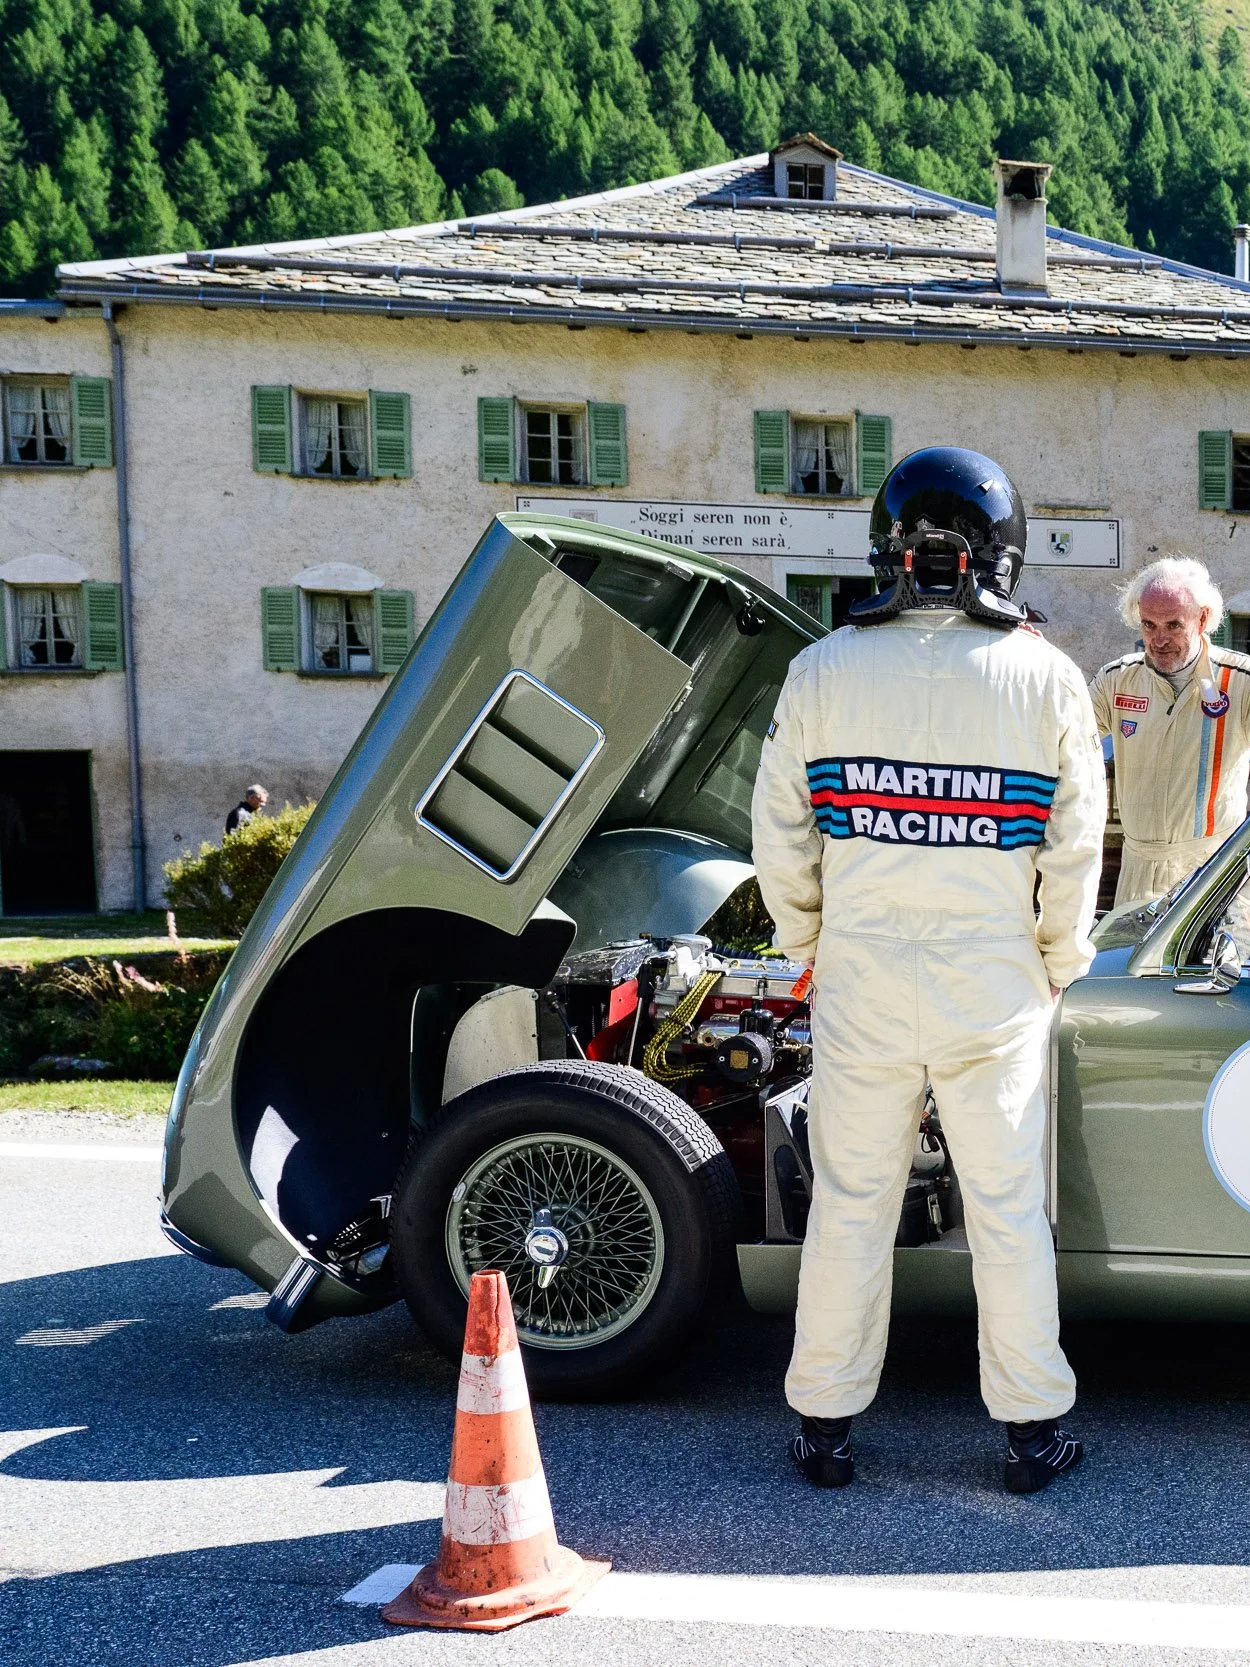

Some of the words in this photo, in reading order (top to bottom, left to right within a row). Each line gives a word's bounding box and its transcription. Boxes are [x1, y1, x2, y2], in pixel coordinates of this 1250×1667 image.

[693, 511, 734, 524] seren
[743, 513, 771, 525] non
[702, 534, 743, 547] seren
[845, 763, 1001, 800] MARTINI
[851, 807, 999, 844] RACING
